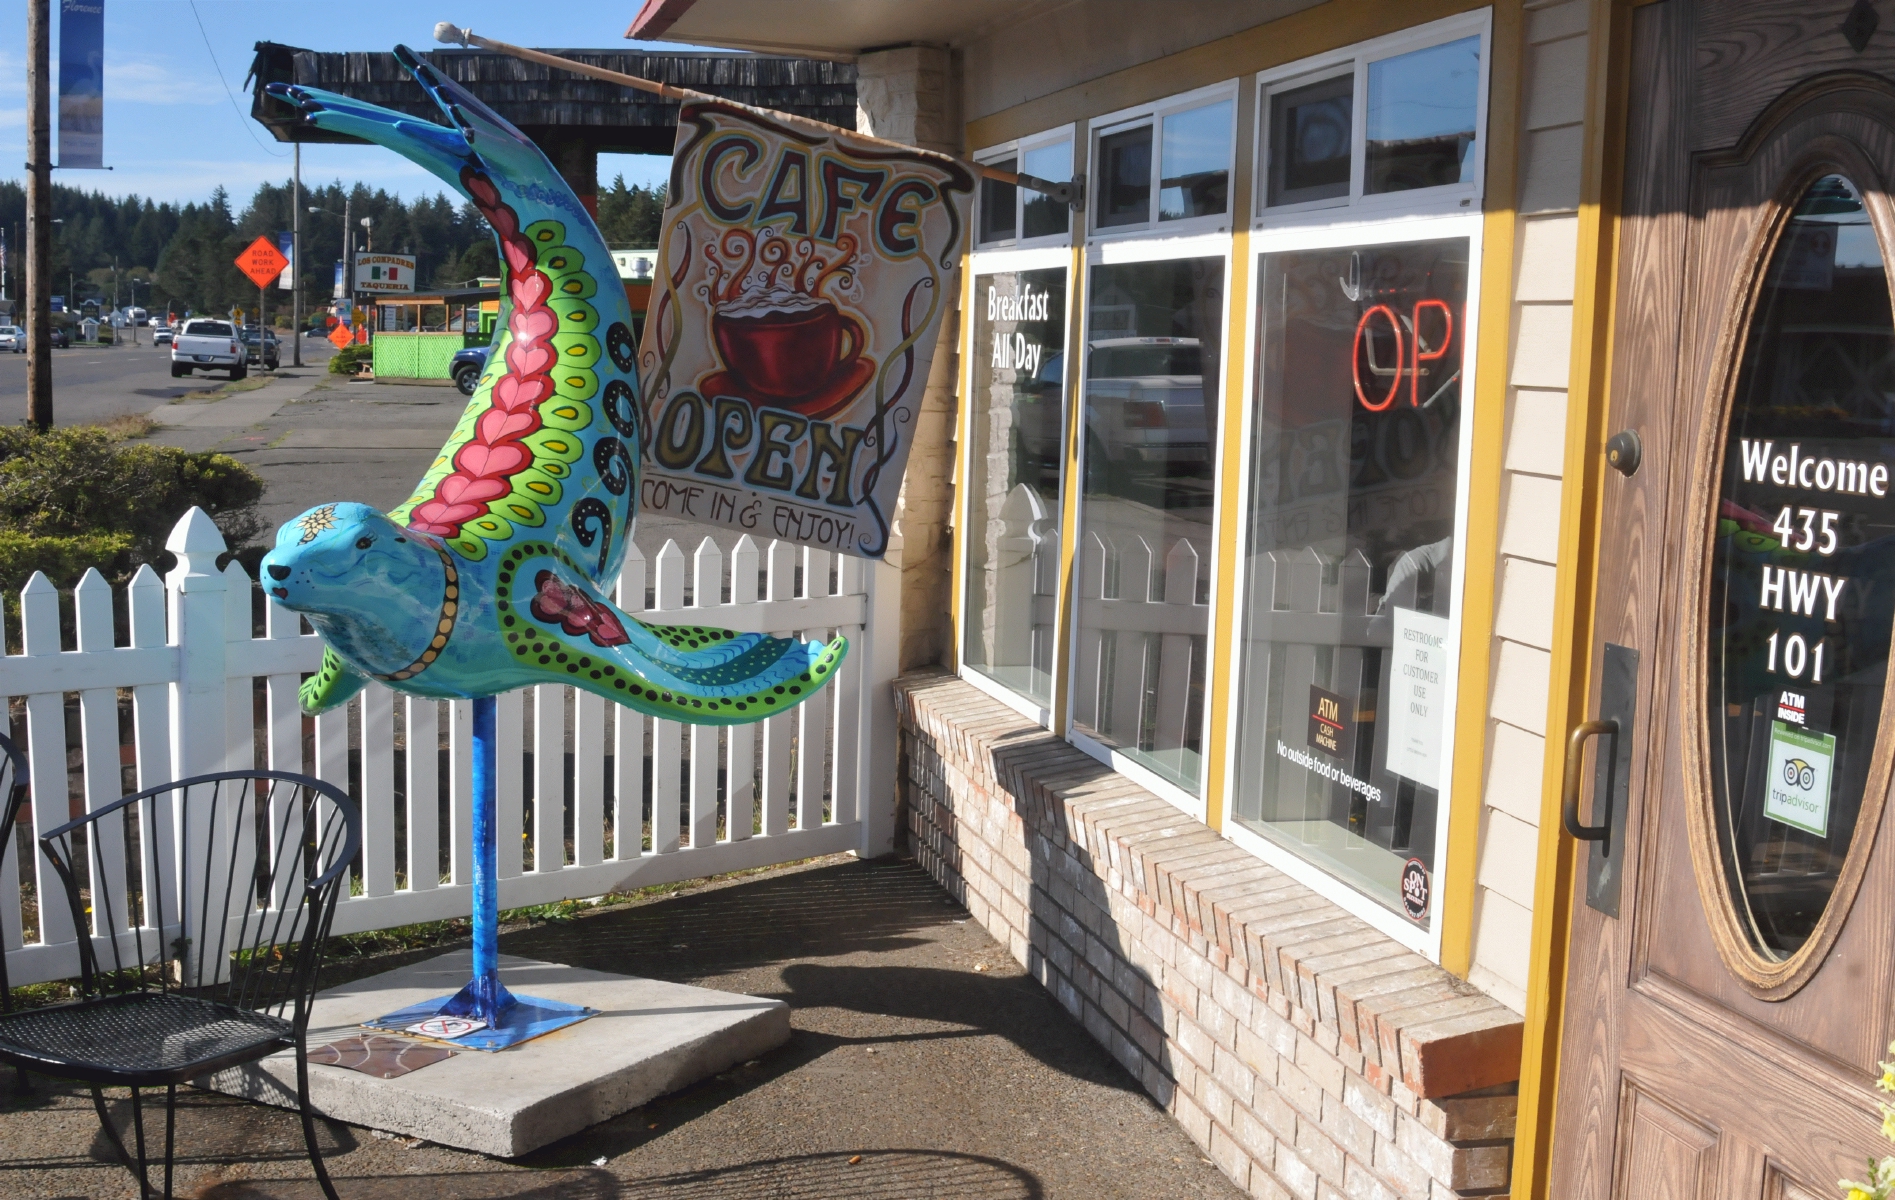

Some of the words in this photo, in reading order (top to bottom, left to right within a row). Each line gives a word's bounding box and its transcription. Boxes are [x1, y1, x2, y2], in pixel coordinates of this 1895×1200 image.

[62, 0, 102, 14] Florence
[700, 134, 938, 257] CAFE
[357, 257, 371, 266] LOS
[372, 256, 415, 270] COMPADRES
[361, 282, 410, 290] TAQUERIA
[987, 283, 1049, 322] Breakfast
[991, 332, 1010, 369] All
[1015, 332, 1041, 379] Day
[1352, 299, 1467, 413] OP
[654, 391, 864, 508] OPEN
[1740, 438, 1888, 498] Welcome
[641, 479, 704, 517] COME
[710, 491, 736, 523] IN
[773, 505, 855, 549] ENJOY!
[1772, 505, 1840, 557] 435
[1759, 564, 1848, 623] HWY
[1403, 627, 1444, 649] RESTROOMS
[1415, 648, 1429, 664] FOR
[1766, 628, 1825, 685] 101
[1402, 663, 1439, 685] CUSTOMER
[1413, 684, 1426, 700] USE
[1779, 691, 1805, 709] ATM
[1317, 697, 1338, 722] ATM
[1410, 701, 1428, 718] ONLY
[1777, 707, 1805, 724] INSIDE
[1315, 733, 1337, 751] MACHINE
[1320, 723, 1334, 738] CASH
[1276, 739, 1287, 758] No
[1287, 748, 1314, 770] outside
[1313, 756, 1331, 778] food
[1331, 768, 1340, 782] or
[1340, 768, 1381, 802] beverages
[1772, 788, 1820, 814] tripadvisor
[1410, 870, 1425, 891] ON
